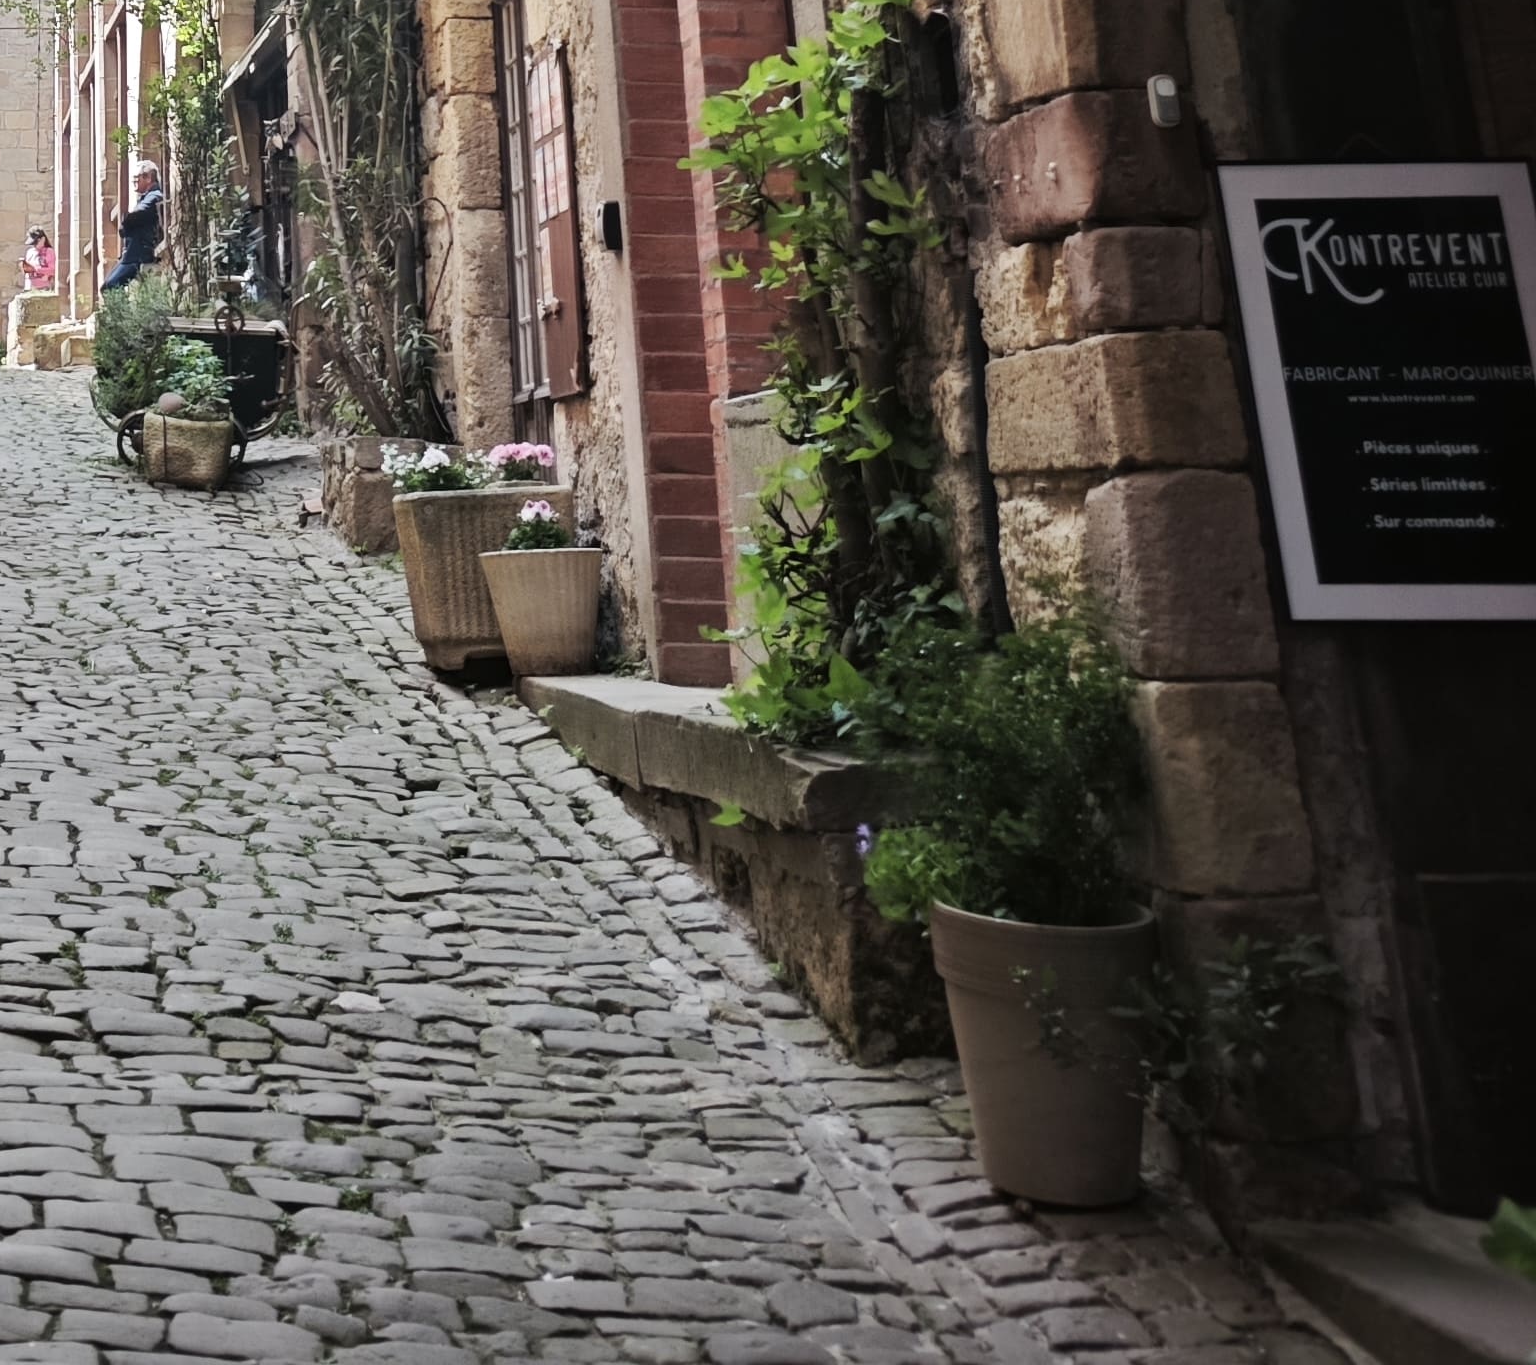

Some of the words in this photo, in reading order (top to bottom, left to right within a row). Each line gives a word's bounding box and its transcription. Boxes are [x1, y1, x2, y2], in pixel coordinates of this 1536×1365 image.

[1260, 217, 1505, 305] KONTREVENT
[1407, 271, 1468, 289] ATELIER
[1474, 271, 1509, 288] CUIR
[1282, 365, 1382, 382] FABRICANT
[1402, 364, 1535, 383] MAROQUINIER
[1362, 440, 1412, 456] Pièces
[1416, 440, 1480, 459] uniques
[1374, 513, 1401, 529] Sur
[1405, 513, 1496, 529] commande
